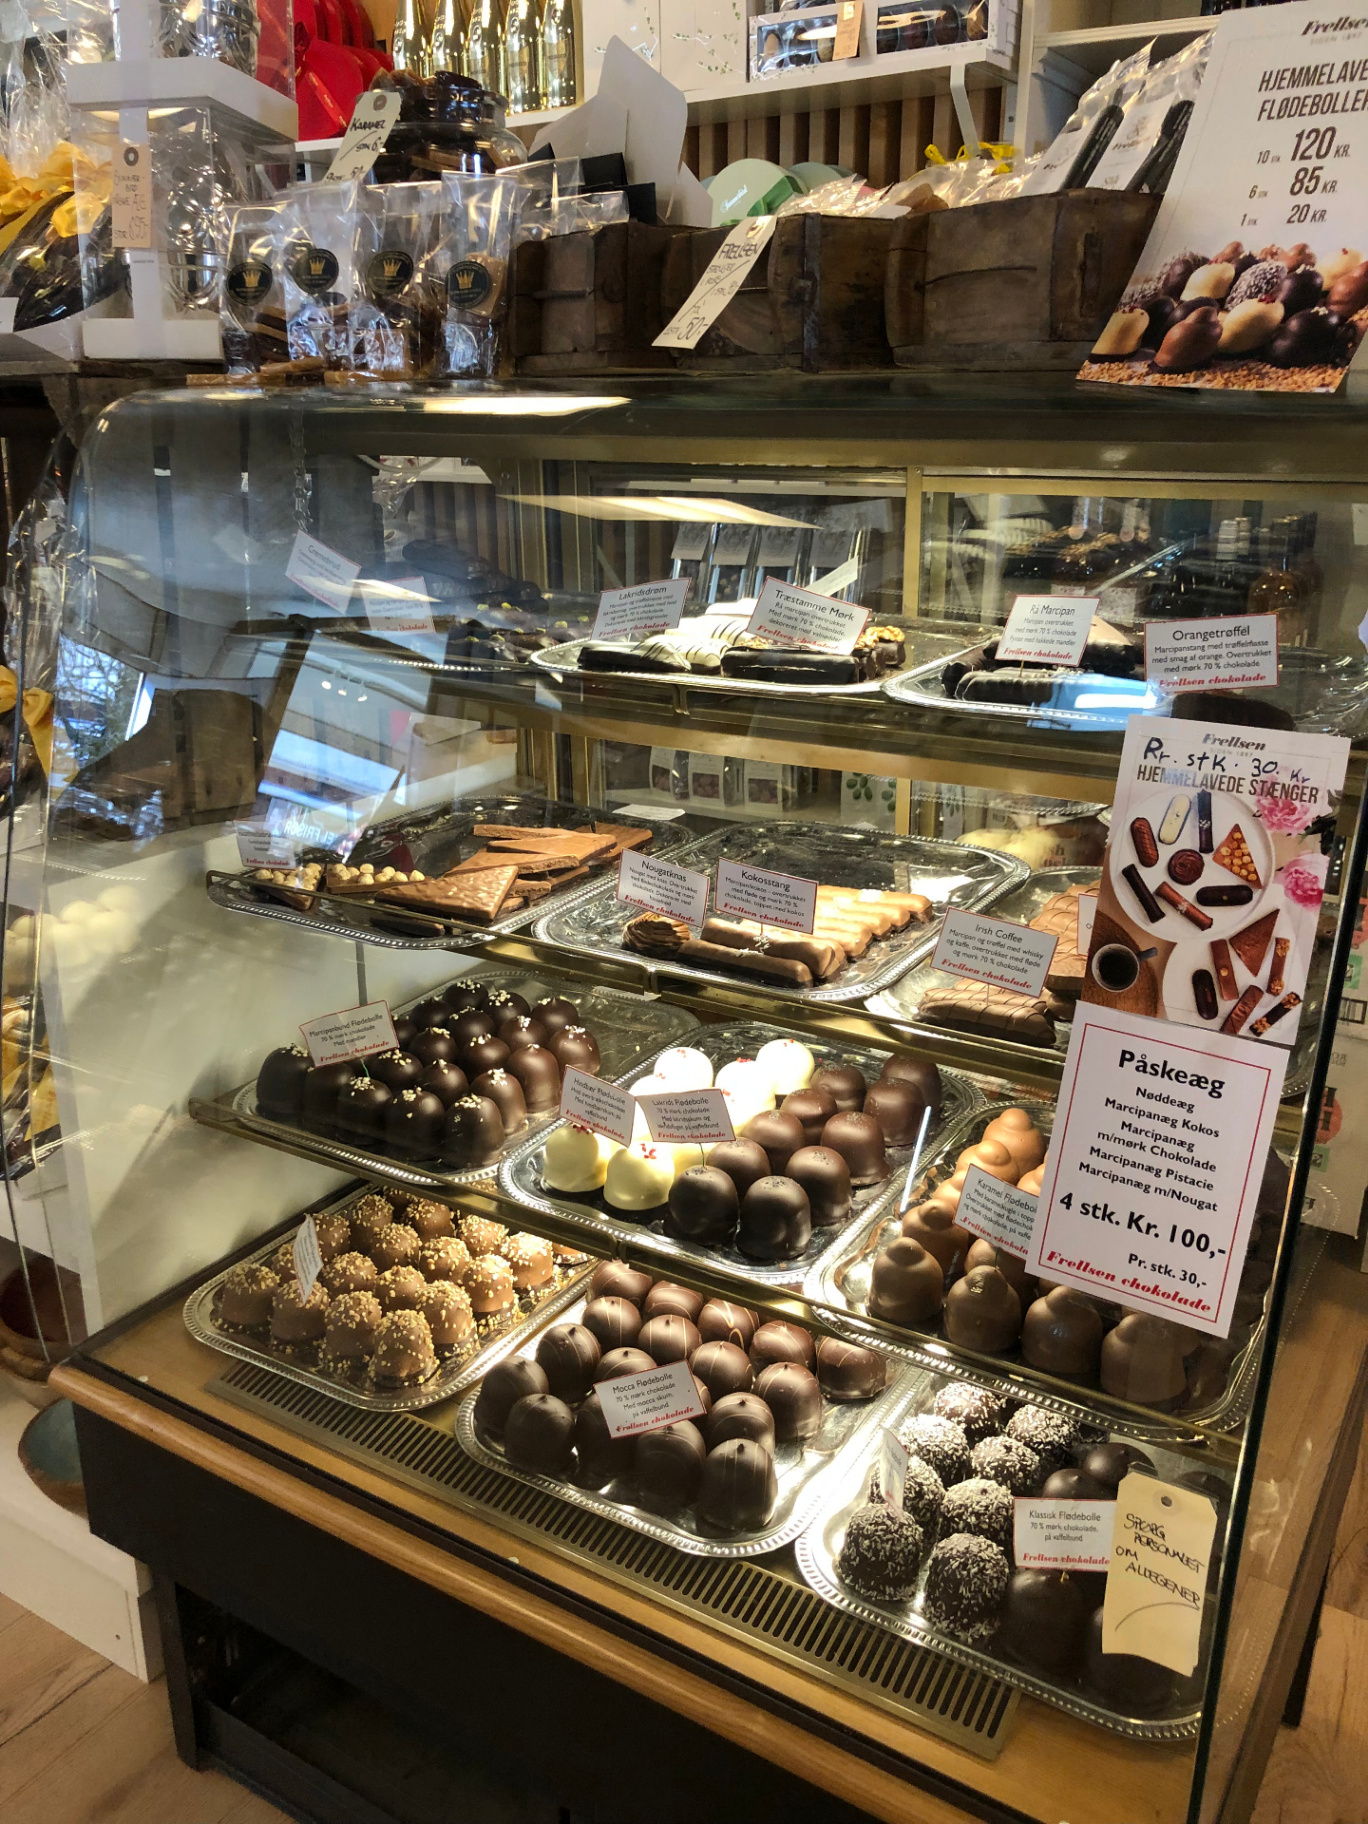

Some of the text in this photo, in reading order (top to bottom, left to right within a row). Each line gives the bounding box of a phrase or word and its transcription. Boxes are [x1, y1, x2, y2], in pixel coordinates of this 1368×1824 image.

[1257, 150, 1270, 164] 10
[1290, 126, 1336, 161] 120
[1334, 144, 1350, 158] KR.
[1249, 185, 1258, 199] 6
[1290, 166, 1324, 196] 85
[1321, 180, 1337, 194] KR.
[1241, 214, 1247, 226] 1
[1286, 204, 1310, 224] 20
[1310, 210, 1326, 222] KR.
[619, 587, 667, 600] Lakridsdrøm
[769, 609, 781, 617] Med
[783, 613, 798, 621] mørk
[776, 589, 854, 621] Træstamme Mørk
[1041, 605, 1075, 617] Marcipan
[757, 625, 794, 641] Frellsen
[769, 618, 797, 631] dekoreret
[1173, 625, 1250, 641] Orangetrøffel
[1004, 648, 1073, 660] Frellsen chokolade
[1155, 643, 1206, 654] Marcipanstang
[1170, 656, 1187, 664] smag
[1226, 650, 1271, 659] Overtrukket
[1164, 665, 1179, 673] med
[1204, 662, 1213, 670] 70
[1223, 660, 1259, 668] chokolade
[1159, 673, 1266, 687] Frellsen chokolade
[1202, 733, 1266, 751] Frellsen
[1137, 764, 1319, 804] HJEMMELAVEDE STÆNGER
[642, 861, 686, 882] Nougatknas
[742, 870, 790, 892] Kokosstang
[625, 895, 695, 922] Frellsen chokolade
[724, 902, 804, 928] Frellsen chokolade
[949, 929, 1044, 960] Marcipan og trøffel med whisky
[976, 924, 1023, 944] Irish Coffee
[962, 951, 978, 962] mørk
[980, 955, 988, 963] 70
[996, 960, 1028, 974] chokolade
[972, 945, 1008, 959] overtrukket
[1009, 955, 1024, 963] med
[1025, 957, 1041, 968] fløde
[941, 958, 1032, 990] Frellsen chokolade
[320, 1041, 389, 1062] Frellsen chokolade
[1118, 1049, 1226, 1100] Påskeæg
[1136, 1086, 1195, 1114] Nøddeæg
[1104, 1097, 1220, 1138] Marcipanæg Kokos
[1121, 1121, 1196, 1153] Marcipanæg
[1097, 1130, 1217, 1173] m/mørk Chokolade
[1089, 1146, 1214, 1192] Marcipanæg Pistacie
[978, 1179, 1002, 1198] Karamel
[1079, 1162, 1218, 1213] Marcipanæg m/Nougat
[962, 1216, 992, 1237] Frellsen
[1059, 1192, 1226, 1260] 4 stk. Kr. 100,-
[1047, 1250, 1212, 1313] Frellsen chokolade
[1128, 1253, 1207, 1289] Pr. stk. 30,-
[613, 1373, 673, 1394] Mocca Flødebolle
[646, 1383, 676, 1396] chokolade
[637, 1398, 656, 1407] mocca
[651, 1406, 695, 1424] chokolade
[1029, 1510, 1101, 1521] Klassisk Flødebolle
[1044, 1534, 1051, 1542] på
[1023, 1553, 1110, 1565] Frellsen chokolade
